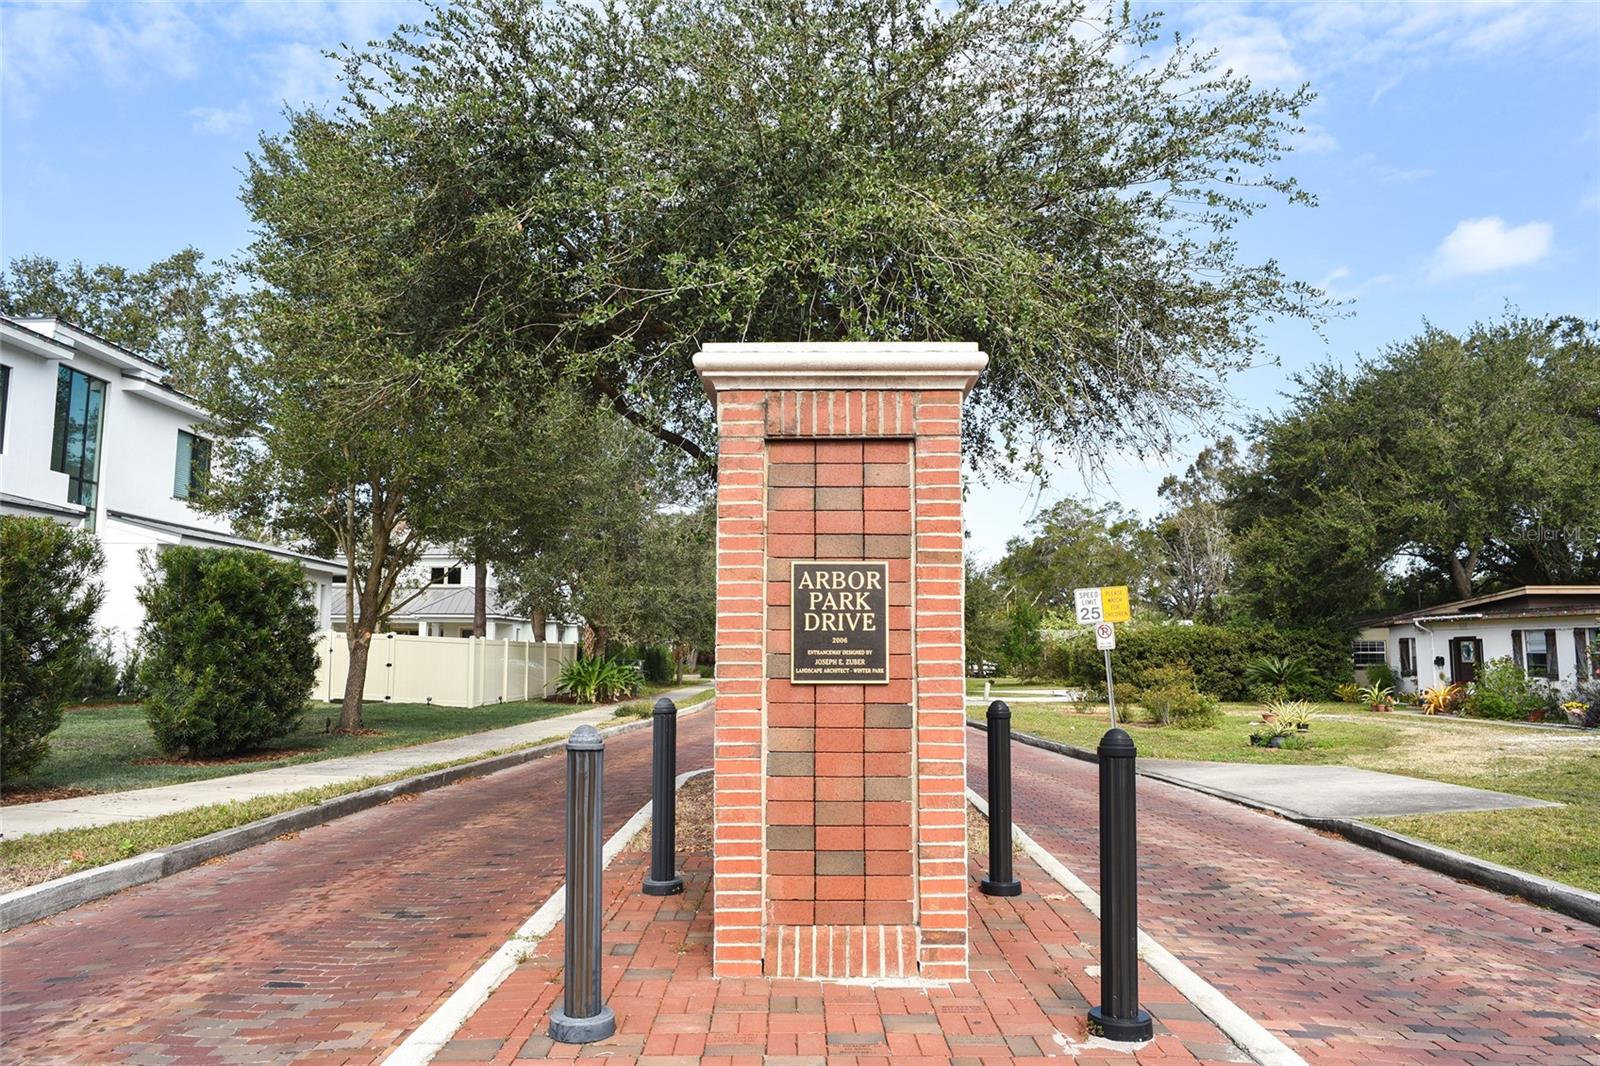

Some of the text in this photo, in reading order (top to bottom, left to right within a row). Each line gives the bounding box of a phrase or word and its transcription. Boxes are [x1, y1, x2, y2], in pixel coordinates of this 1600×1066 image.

[798, 571, 882, 589] ARBOR
[809, 592, 871, 610] PARK
[804, 613, 876, 631] DRIVE
[1081, 607, 1101, 620] 25
